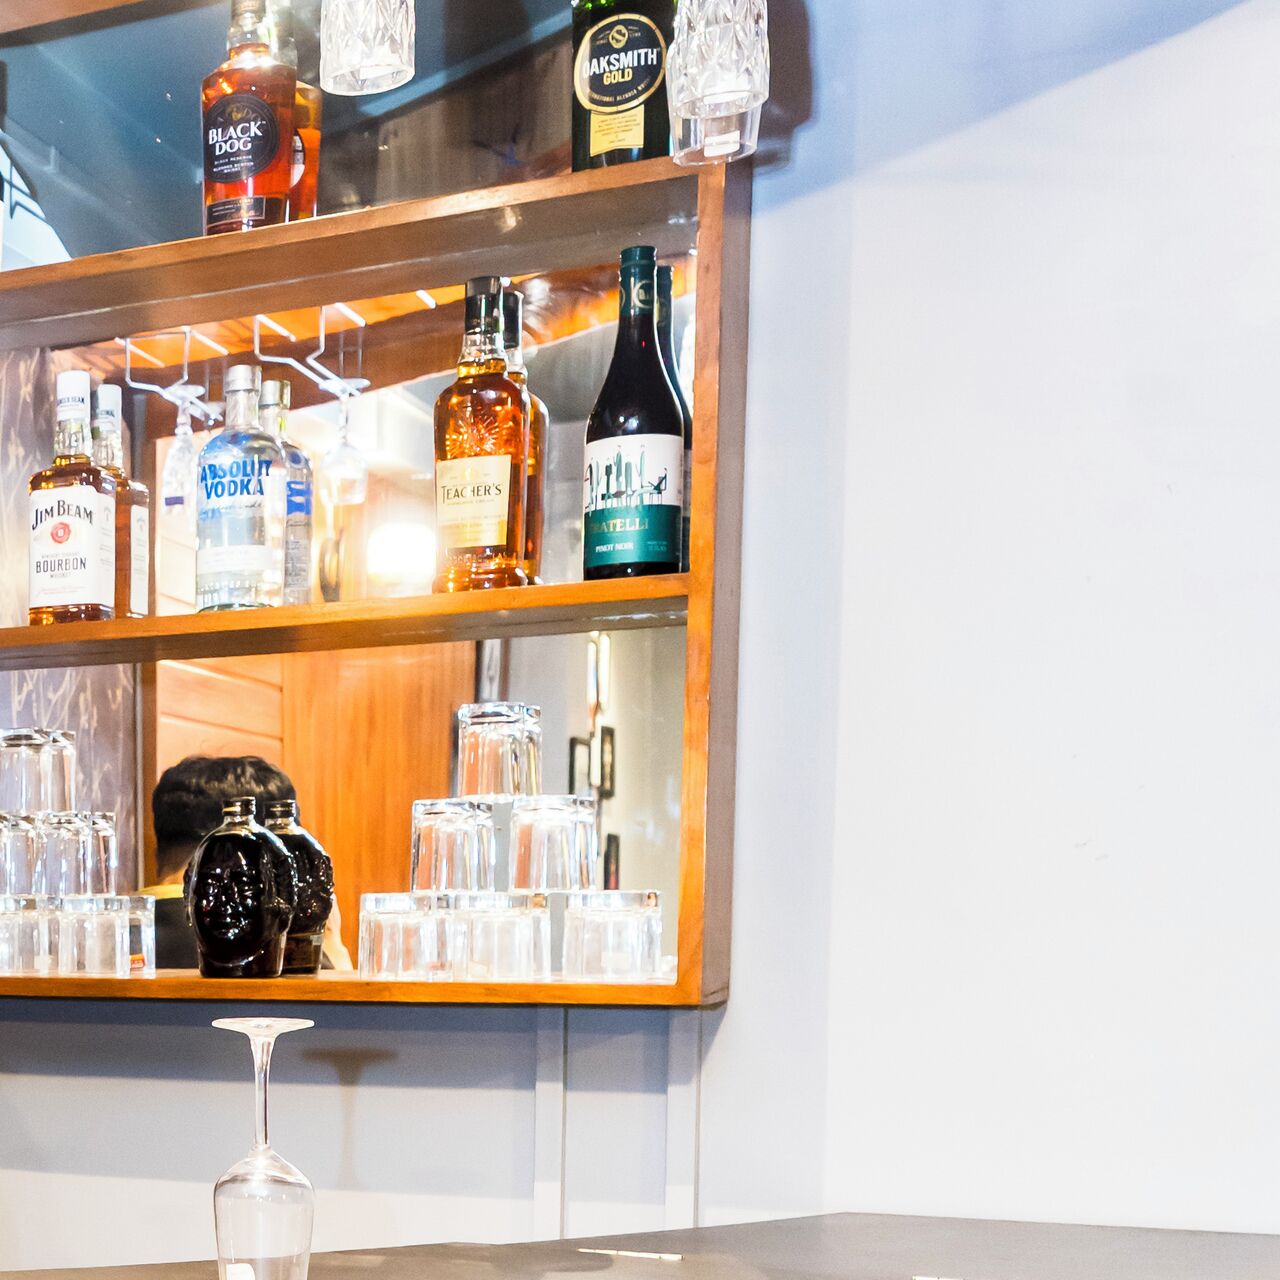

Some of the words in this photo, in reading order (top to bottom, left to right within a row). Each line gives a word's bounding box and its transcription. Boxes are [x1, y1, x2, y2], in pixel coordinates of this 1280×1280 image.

[582, 47, 658, 79] OAKSMITH
[603, 68, 633, 85] GOLD
[208, 121, 263, 145] BLACK
[215, 138, 252, 156] DOG
[200, 460, 273, 484] ABSOLUT
[205, 479, 265, 500] VODKA
[441, 483, 502, 505] TEACHER'S
[31, 506, 54, 531] JIM
[57, 500, 93, 525] BEAM
[36, 558, 87, 574] BOURBON
